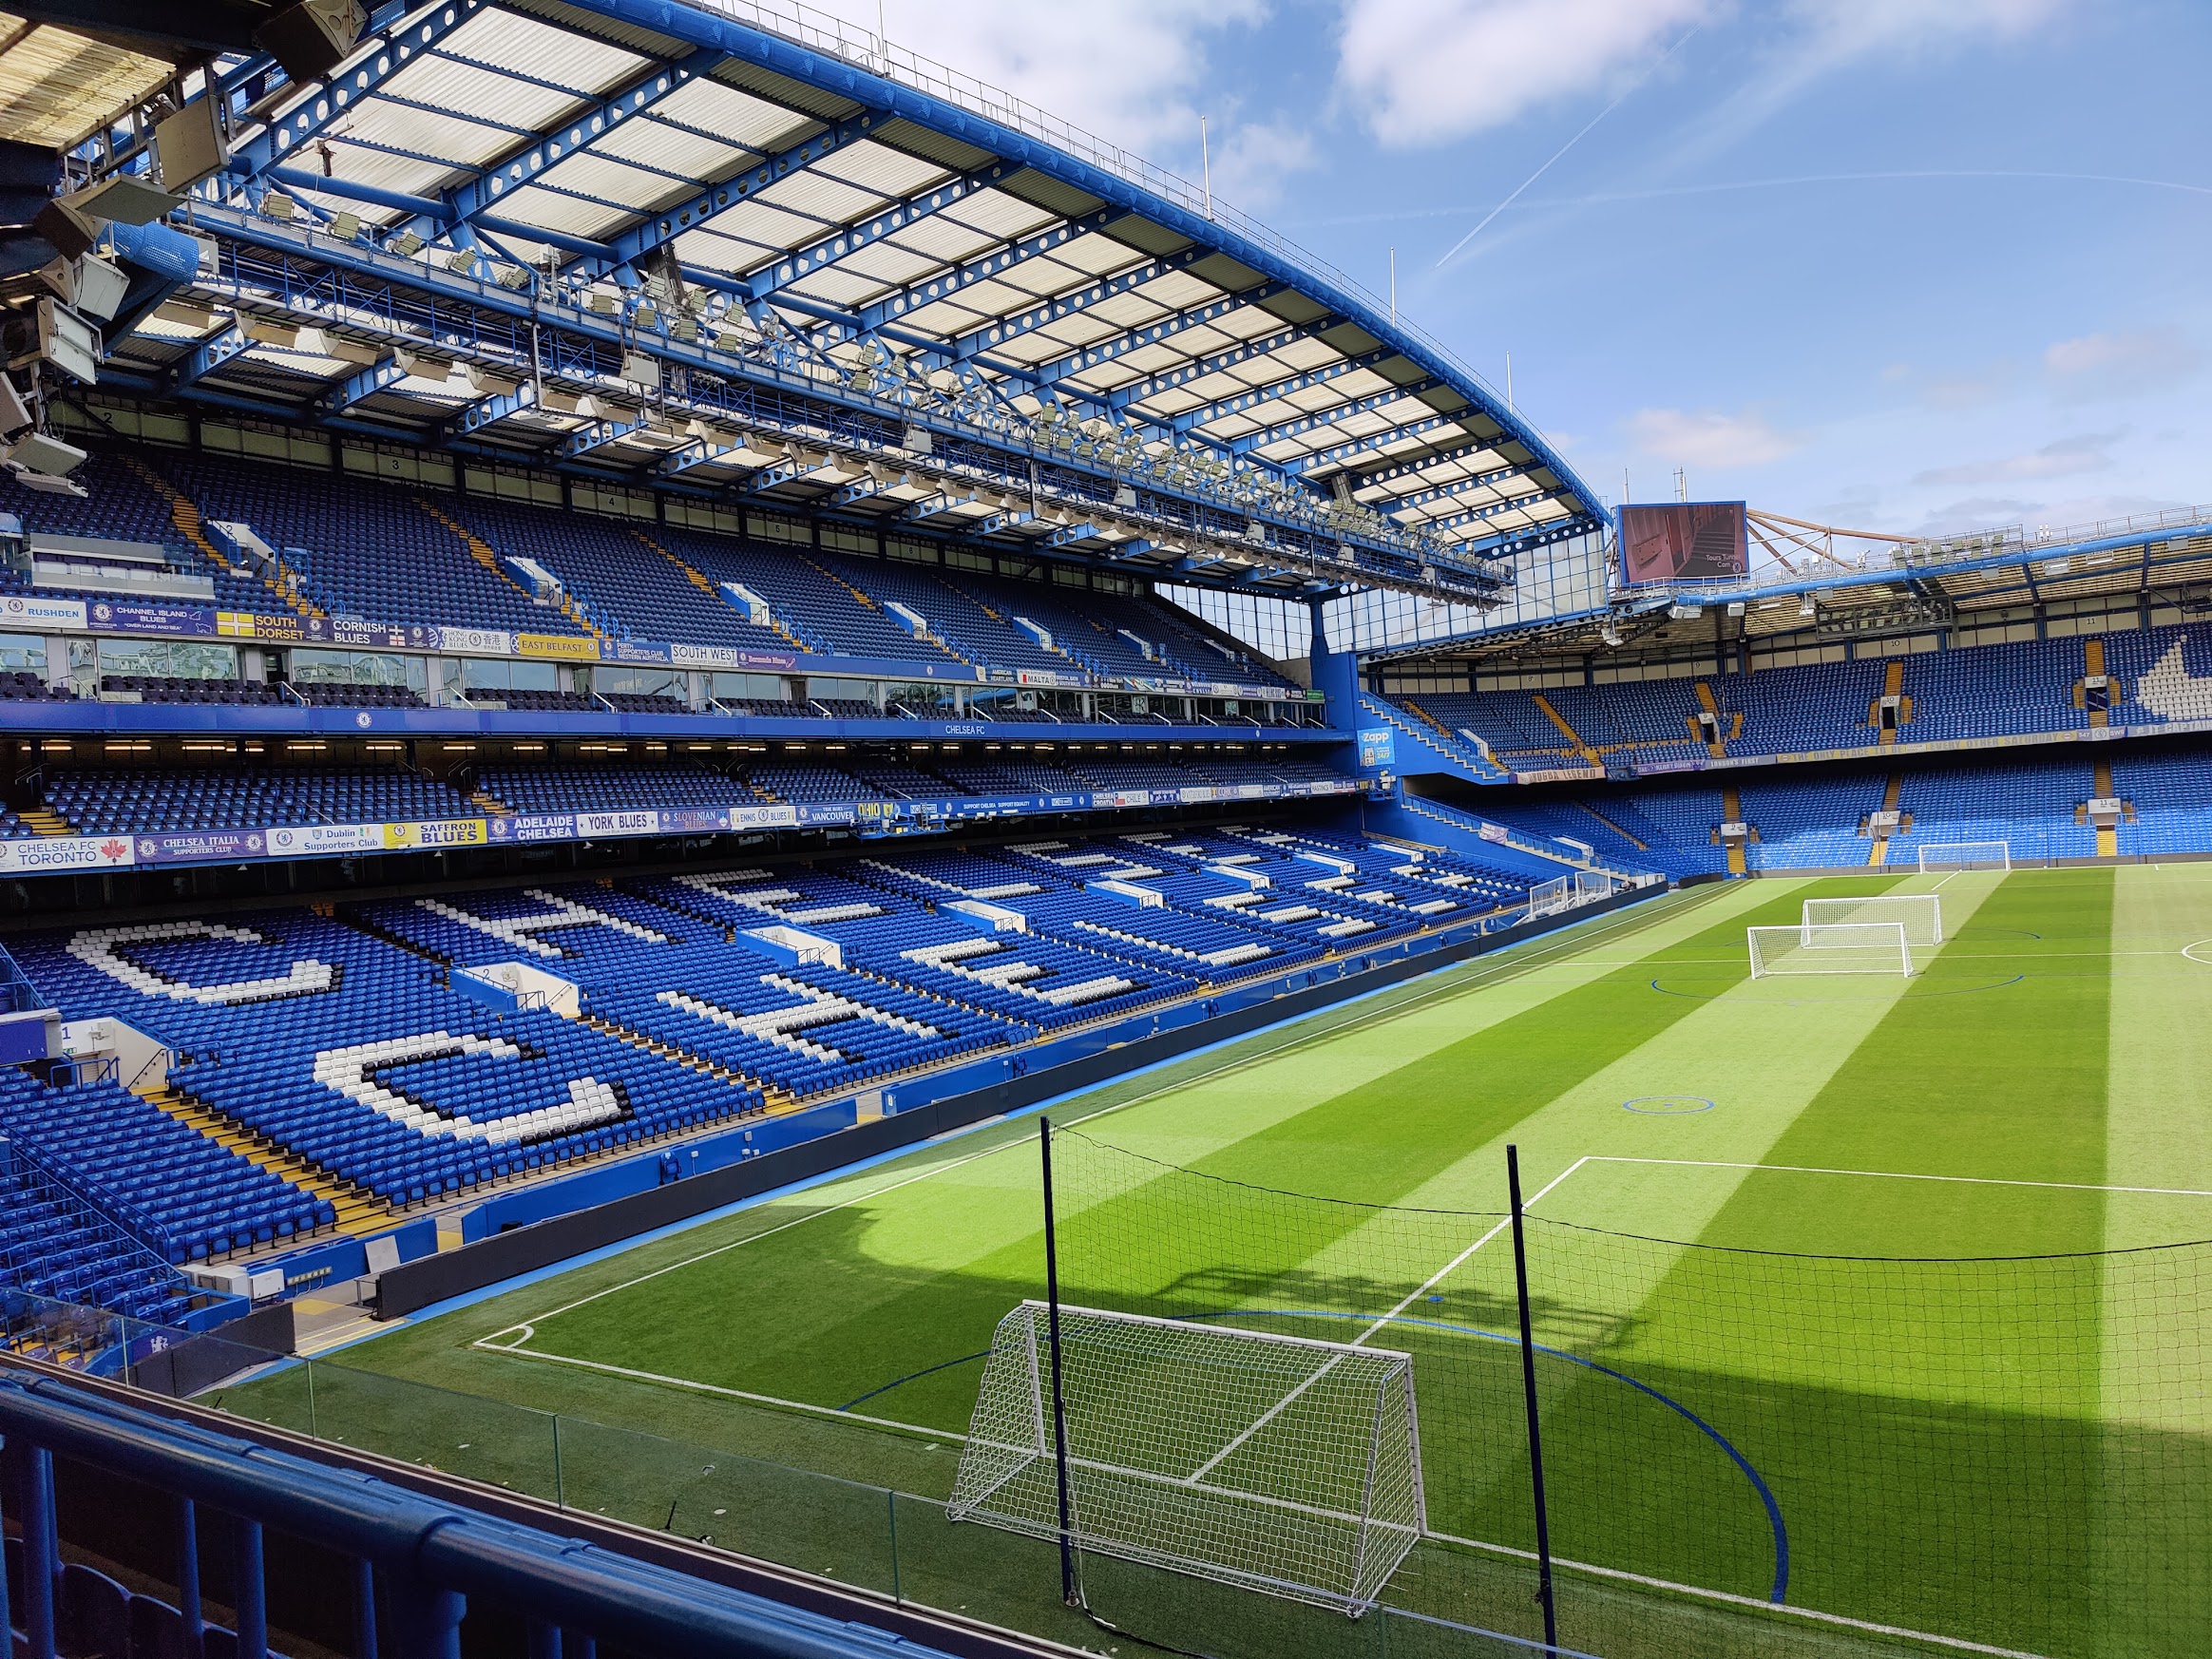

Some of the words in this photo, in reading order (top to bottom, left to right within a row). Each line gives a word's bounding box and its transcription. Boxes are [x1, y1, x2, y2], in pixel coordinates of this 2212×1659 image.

[104, 412, 112, 424] 2
[391, 460, 399, 470] 3
[608, 497, 615, 506] 4
[775, 525, 780, 534] 5
[28, 608, 79, 618] RUSHDEN
[117, 607, 157, 617] CHANNEL
[159, 610, 187, 619] ISLAND
[256, 616, 296, 628] SOUTH
[333, 620, 387, 634] CORNISH
[257, 628, 304, 640] DORSET
[334, 632, 371, 645] BLUES
[522, 639, 543, 650] EAST
[546, 641, 582, 653] BELFAST
[618, 648, 651, 657] SUPPORTERS
[618, 653, 641, 661] WESTERN
[641, 654, 669, 662] AUSTRALIA
[673, 646, 707, 659] SOUTH
[711, 648, 736, 661] WEST
[1028, 676, 1050, 684] MALTA
[944, 725, 976, 734] CHELSEA
[976, 725, 985, 734] FC
[1363, 732, 1389, 744] Zapp
[1930, 741, 1960, 751] EVERY
[1966, 737, 1999, 749] OTHER
[2004, 733, 2058, 745] SATURDAY
[1792, 753, 1810, 762] THE
[1813, 752, 1835, 760] ONLY
[1840, 748, 1869, 759] PLACE
[1874, 747, 1886, 755] TO
[1891, 745, 1903, 753] BE
[1563, 768, 1595, 779] LEGEND
[674, 810, 716, 822] SLOVENIAN
[811, 810, 854, 822] VANCOUVER
[858, 803, 881, 817] OHIO
[514, 816, 574, 830] ADELAIDE
[588, 815, 614, 830] YORK
[619, 814, 647, 829] BLUES
[740, 814, 755, 823] ENNIS
[771, 812, 787, 821] BLUES
[420, 822, 476, 832] SAFFRON
[684, 820, 707, 830] BLUES
[326, 829, 355, 838] Dublin
[421, 830, 478, 844] BLUES
[517, 827, 573, 841] CHELSEA
[18, 842, 76, 853] CHELSEA
[80, 841, 96, 851] FC
[163, 837, 205, 848] CHELSEA
[209, 835, 239, 846] ITALIA
[304, 840, 355, 851] Supporters
[358, 838, 378, 848] Club
[173, 847, 214, 855] SUPPORTERS
[216, 846, 232, 854] CLUB
[19, 851, 97, 866] TORONTO
[483, 968, 490, 980] 2
[62, 1026, 72, 1039] 1
